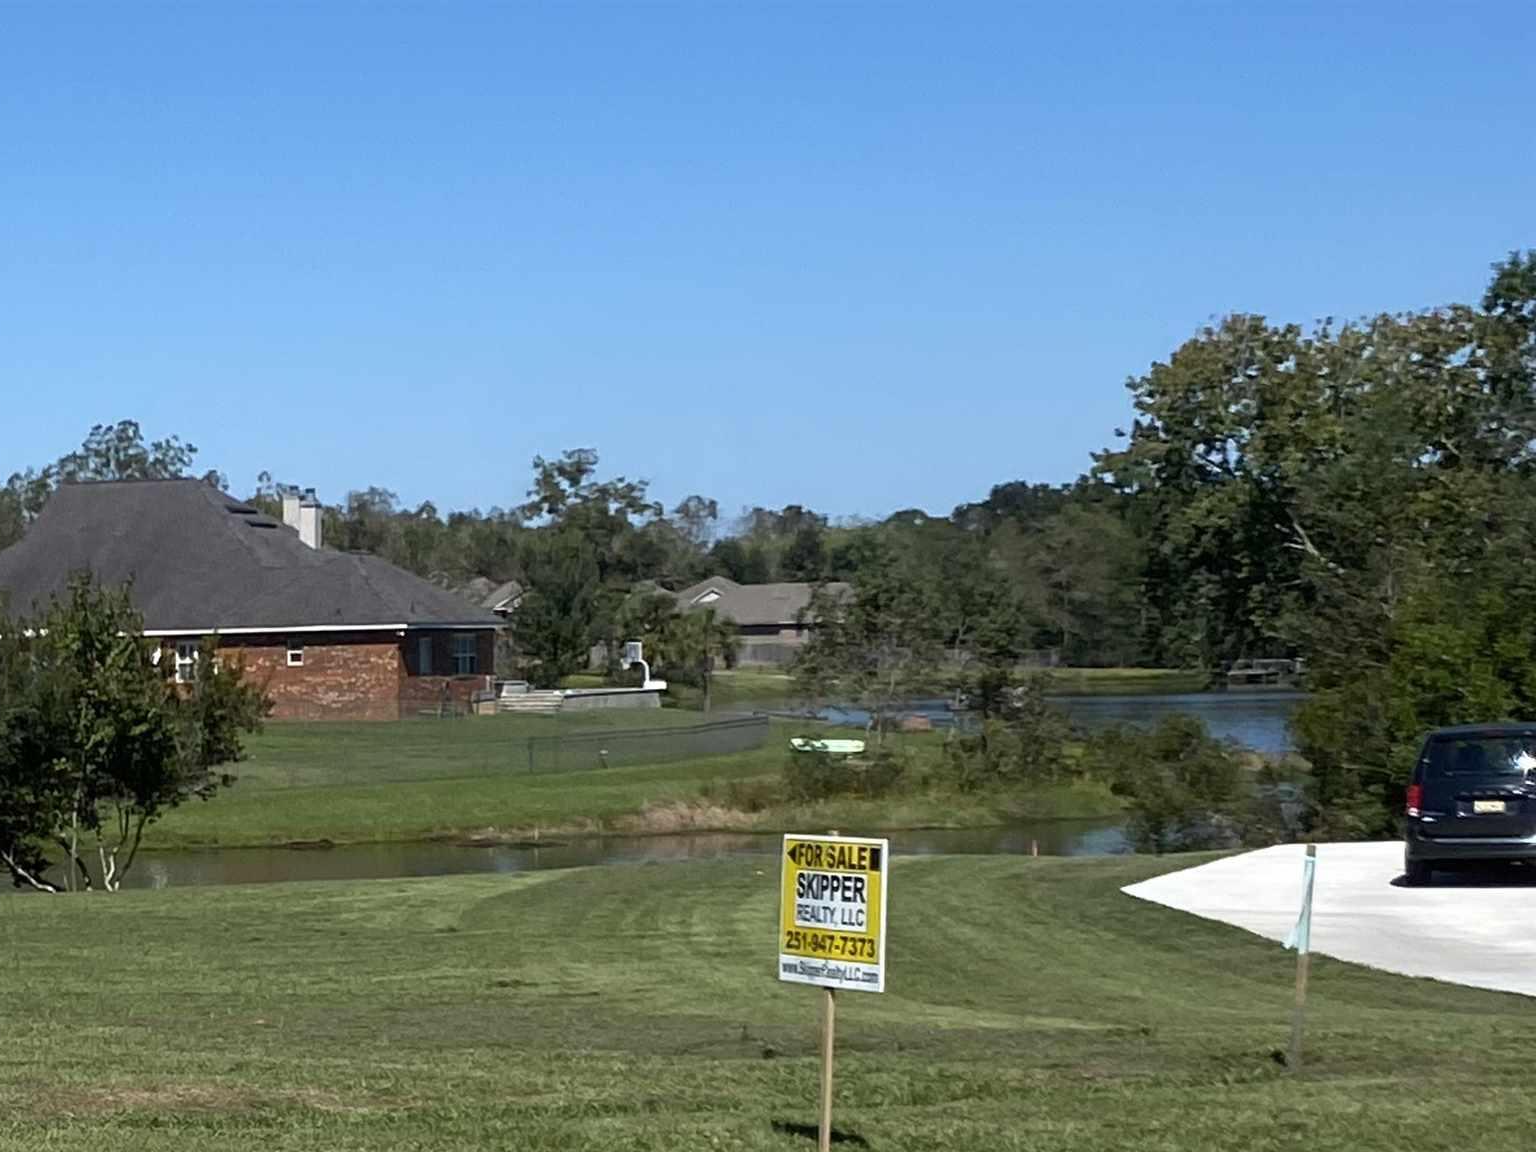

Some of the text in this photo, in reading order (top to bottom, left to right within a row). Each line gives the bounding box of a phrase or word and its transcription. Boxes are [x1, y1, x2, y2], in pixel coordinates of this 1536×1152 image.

[797, 844, 867, 870] FOR SALE
[797, 872, 866, 903] SKIPPER
[798, 903, 865, 927] REALTY, LLC
[786, 930, 876, 958] 251-947-7373
